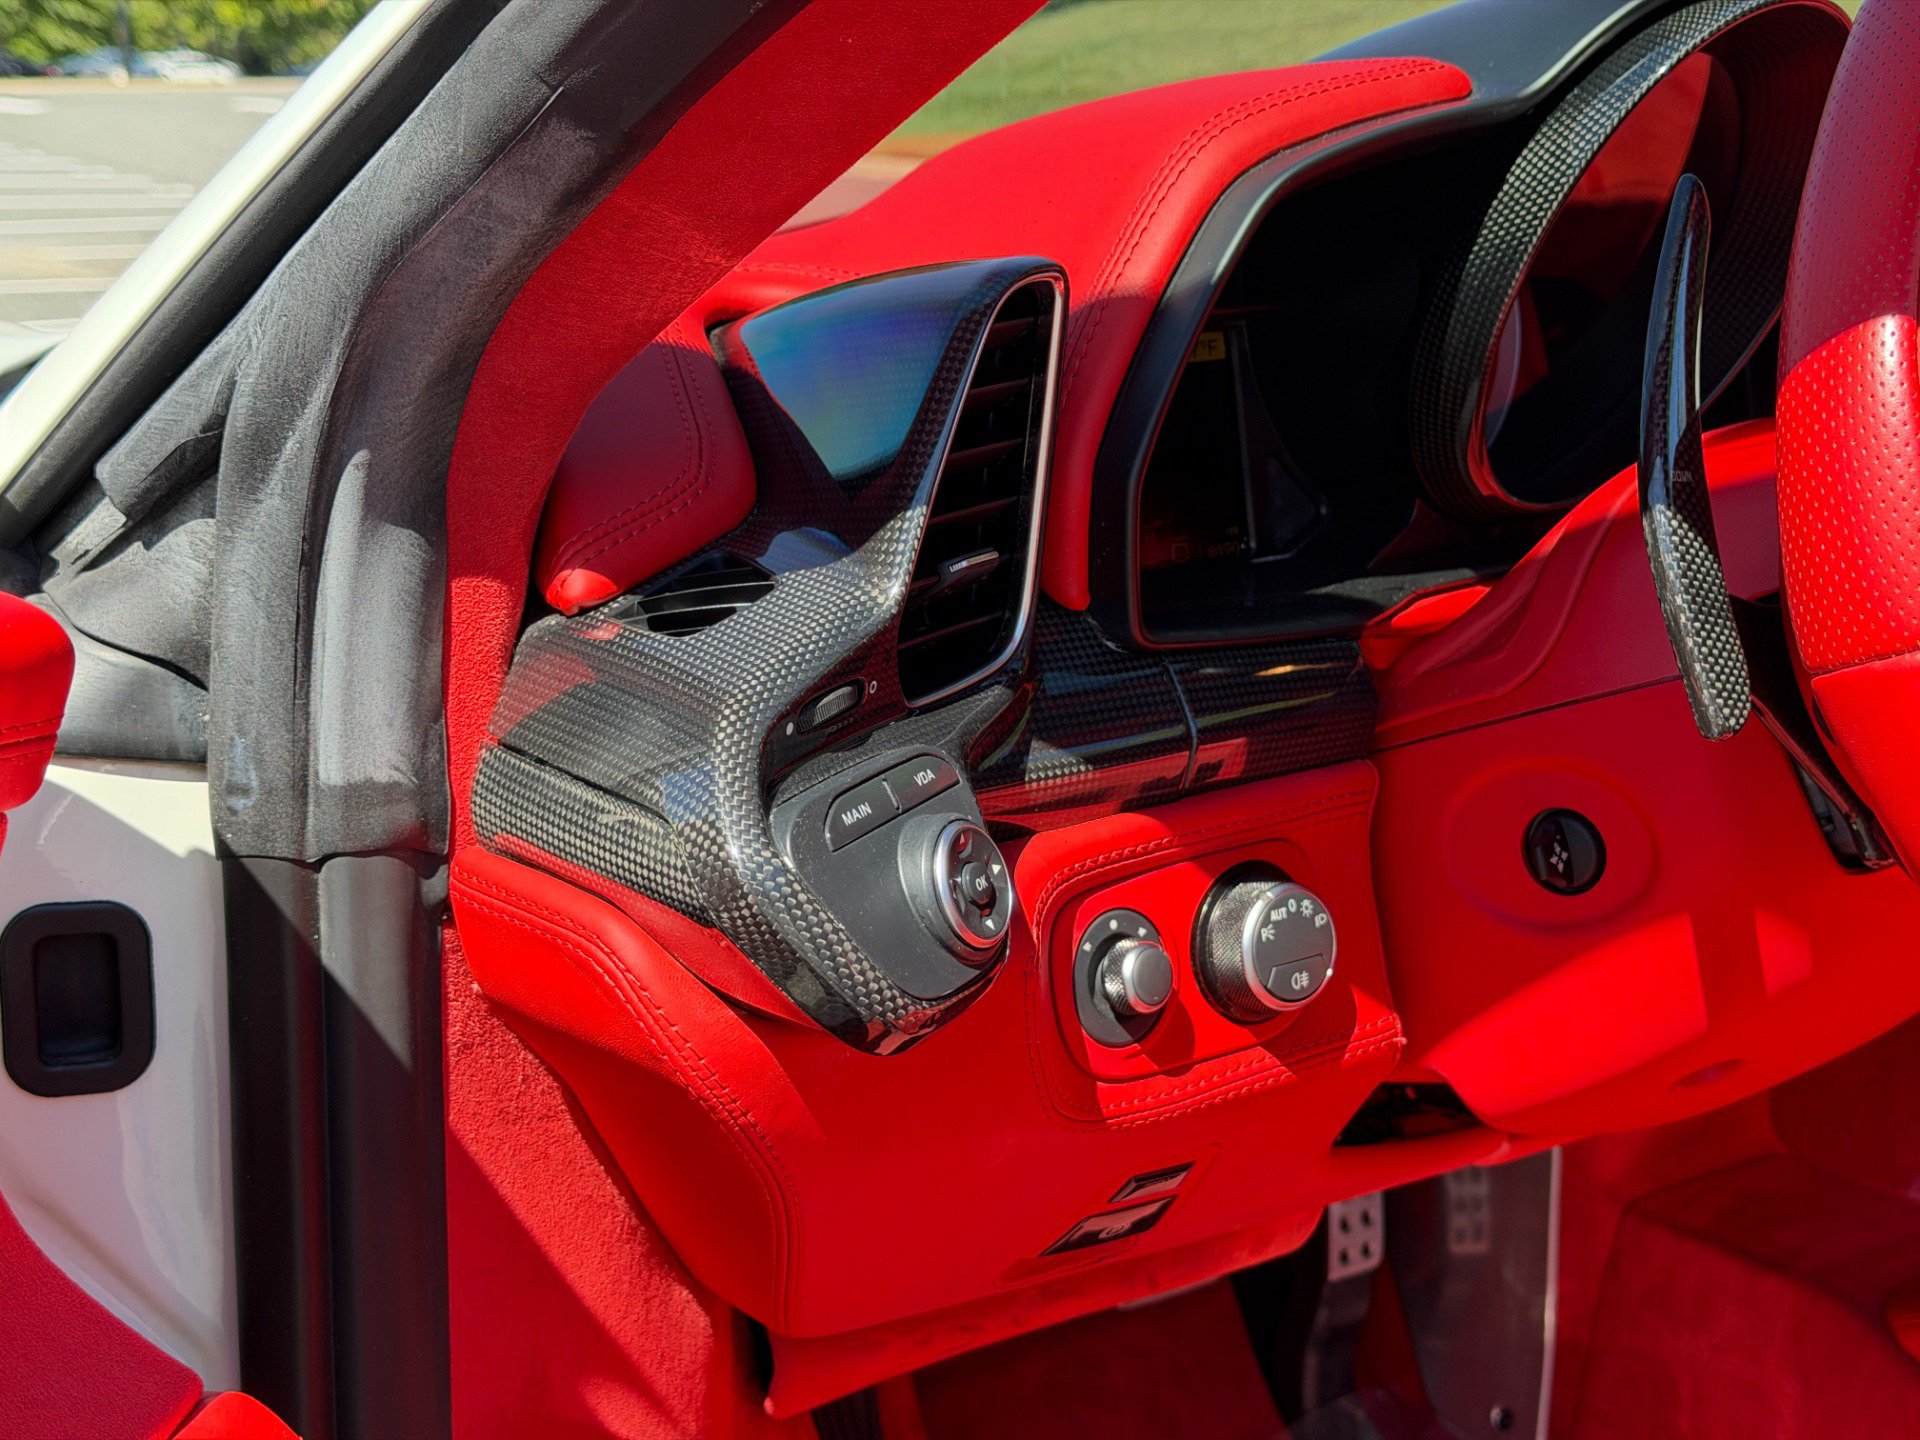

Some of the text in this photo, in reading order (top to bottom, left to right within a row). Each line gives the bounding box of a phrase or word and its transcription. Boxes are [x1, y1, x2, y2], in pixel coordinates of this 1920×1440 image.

[913, 768, 935, 787] VDA
[841, 802, 872, 826] MAIN
[975, 874, 988, 891] OK
